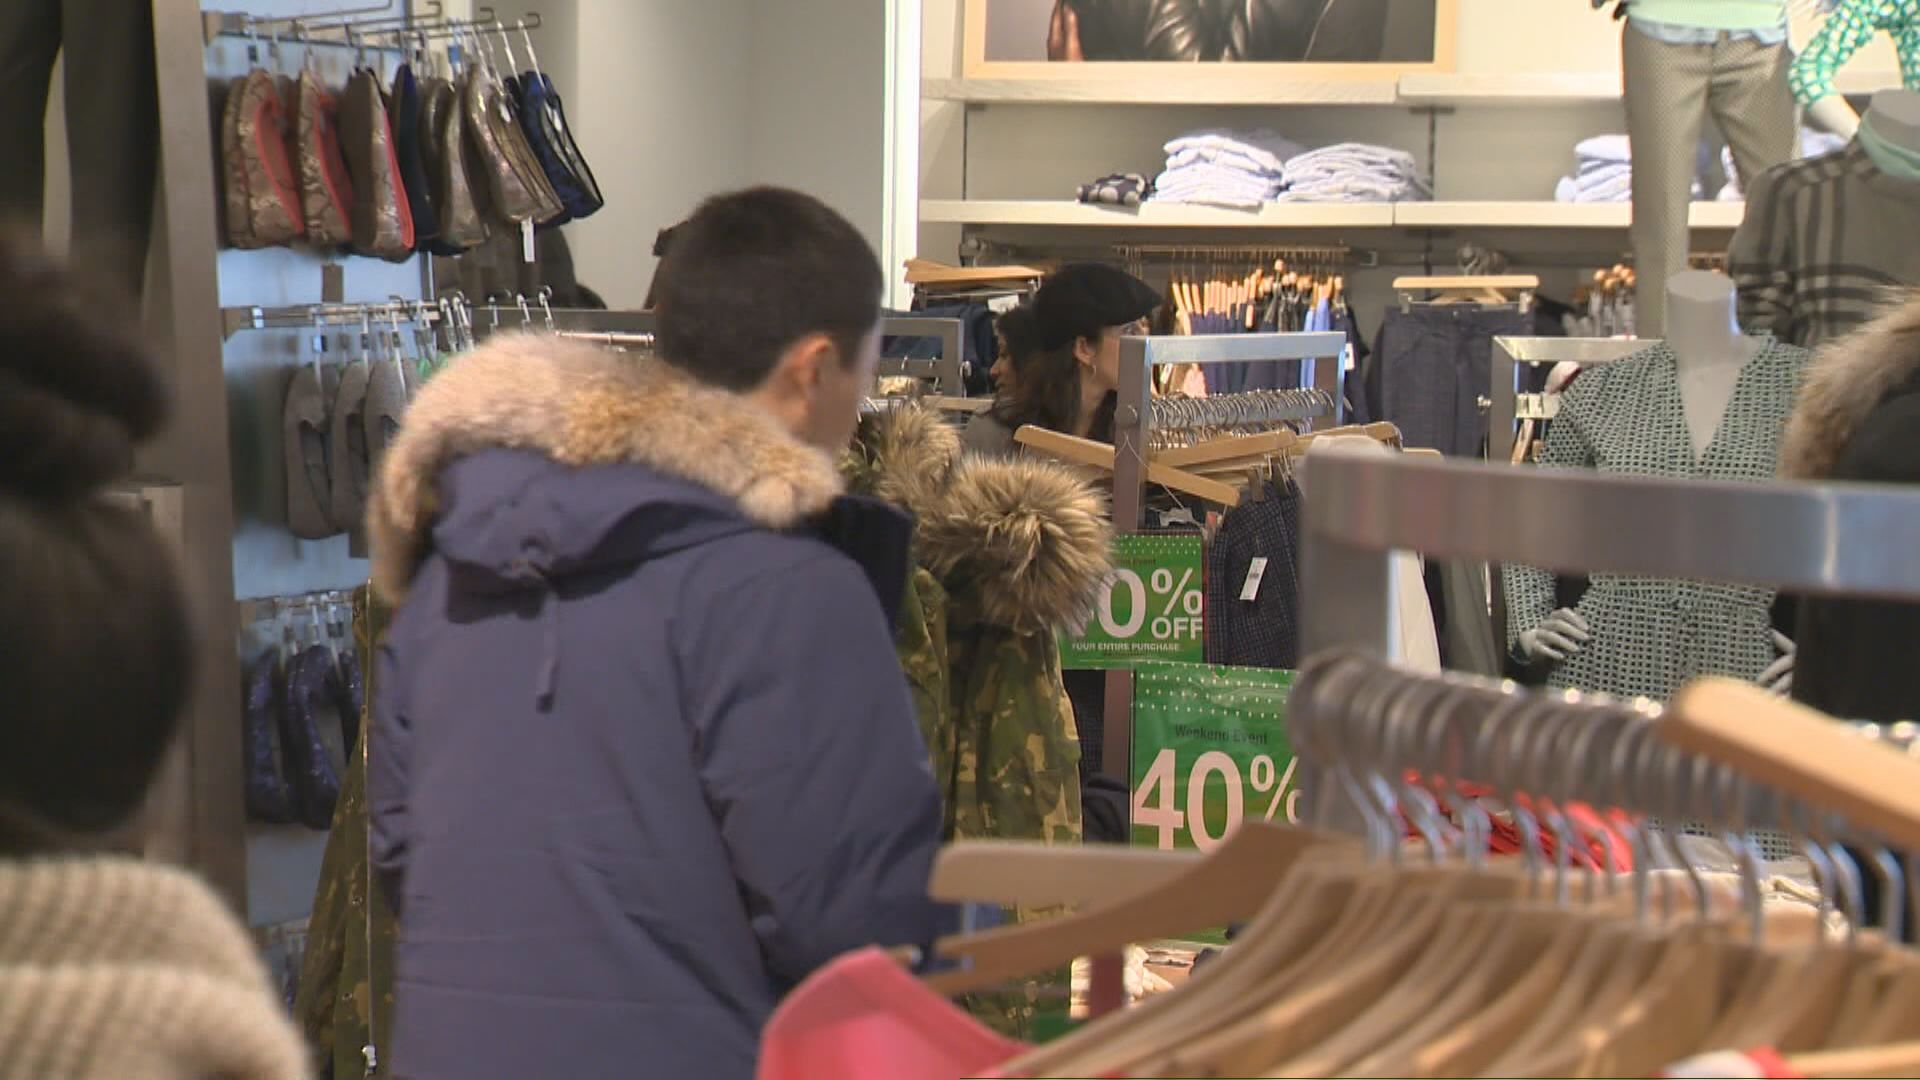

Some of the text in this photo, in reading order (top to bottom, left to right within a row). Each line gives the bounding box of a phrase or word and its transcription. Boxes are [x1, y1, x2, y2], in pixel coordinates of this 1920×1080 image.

[1075, 567, 1203, 638] 0%
[1151, 617, 1203, 640] OFF
[1072, 642, 1180, 652] YOUR ENTIRE PURCHASE
[1175, 723, 1267, 744] Weekend Event
[1131, 748, 1303, 854] 40%
